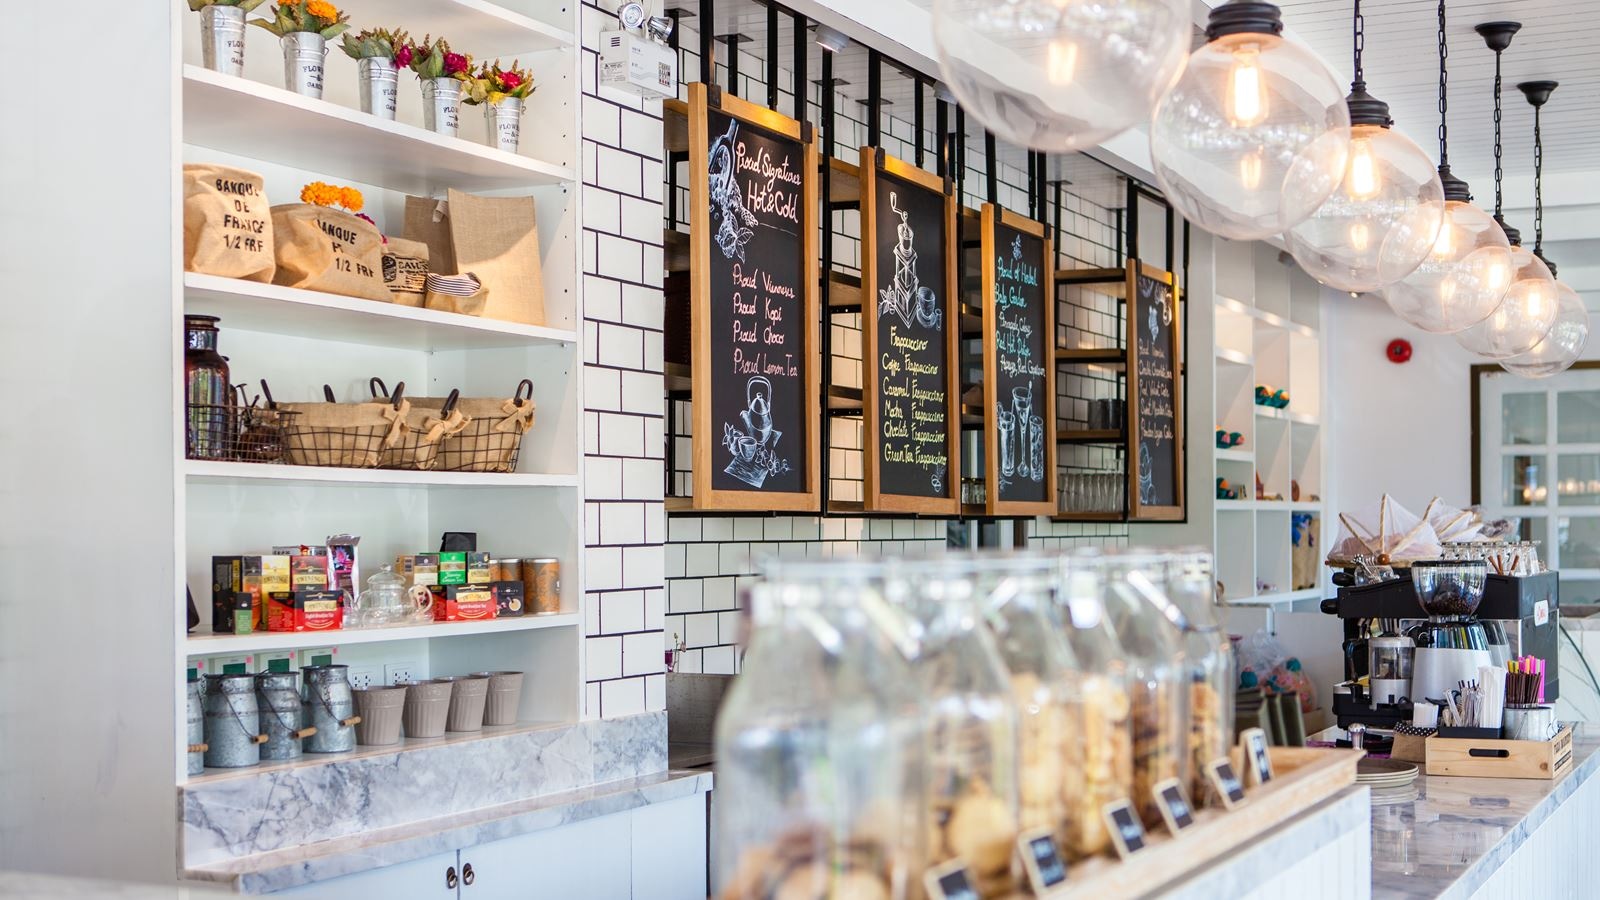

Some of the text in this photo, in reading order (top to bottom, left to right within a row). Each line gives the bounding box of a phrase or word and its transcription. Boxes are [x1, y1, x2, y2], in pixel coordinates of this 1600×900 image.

[234, 199, 250, 213] DE
[224, 214, 265, 233] FRANCE
[317, 219, 357, 245] ANQUE
[223, 234, 264, 252] 1/2 FRF
[335, 257, 351, 272] 1/2
[733, 263, 758, 289] Proud
[733, 292, 782, 326] Proud Kopi
[733, 319, 757, 343] Proud
[734, 347, 798, 377] Proud Lemon Tea
